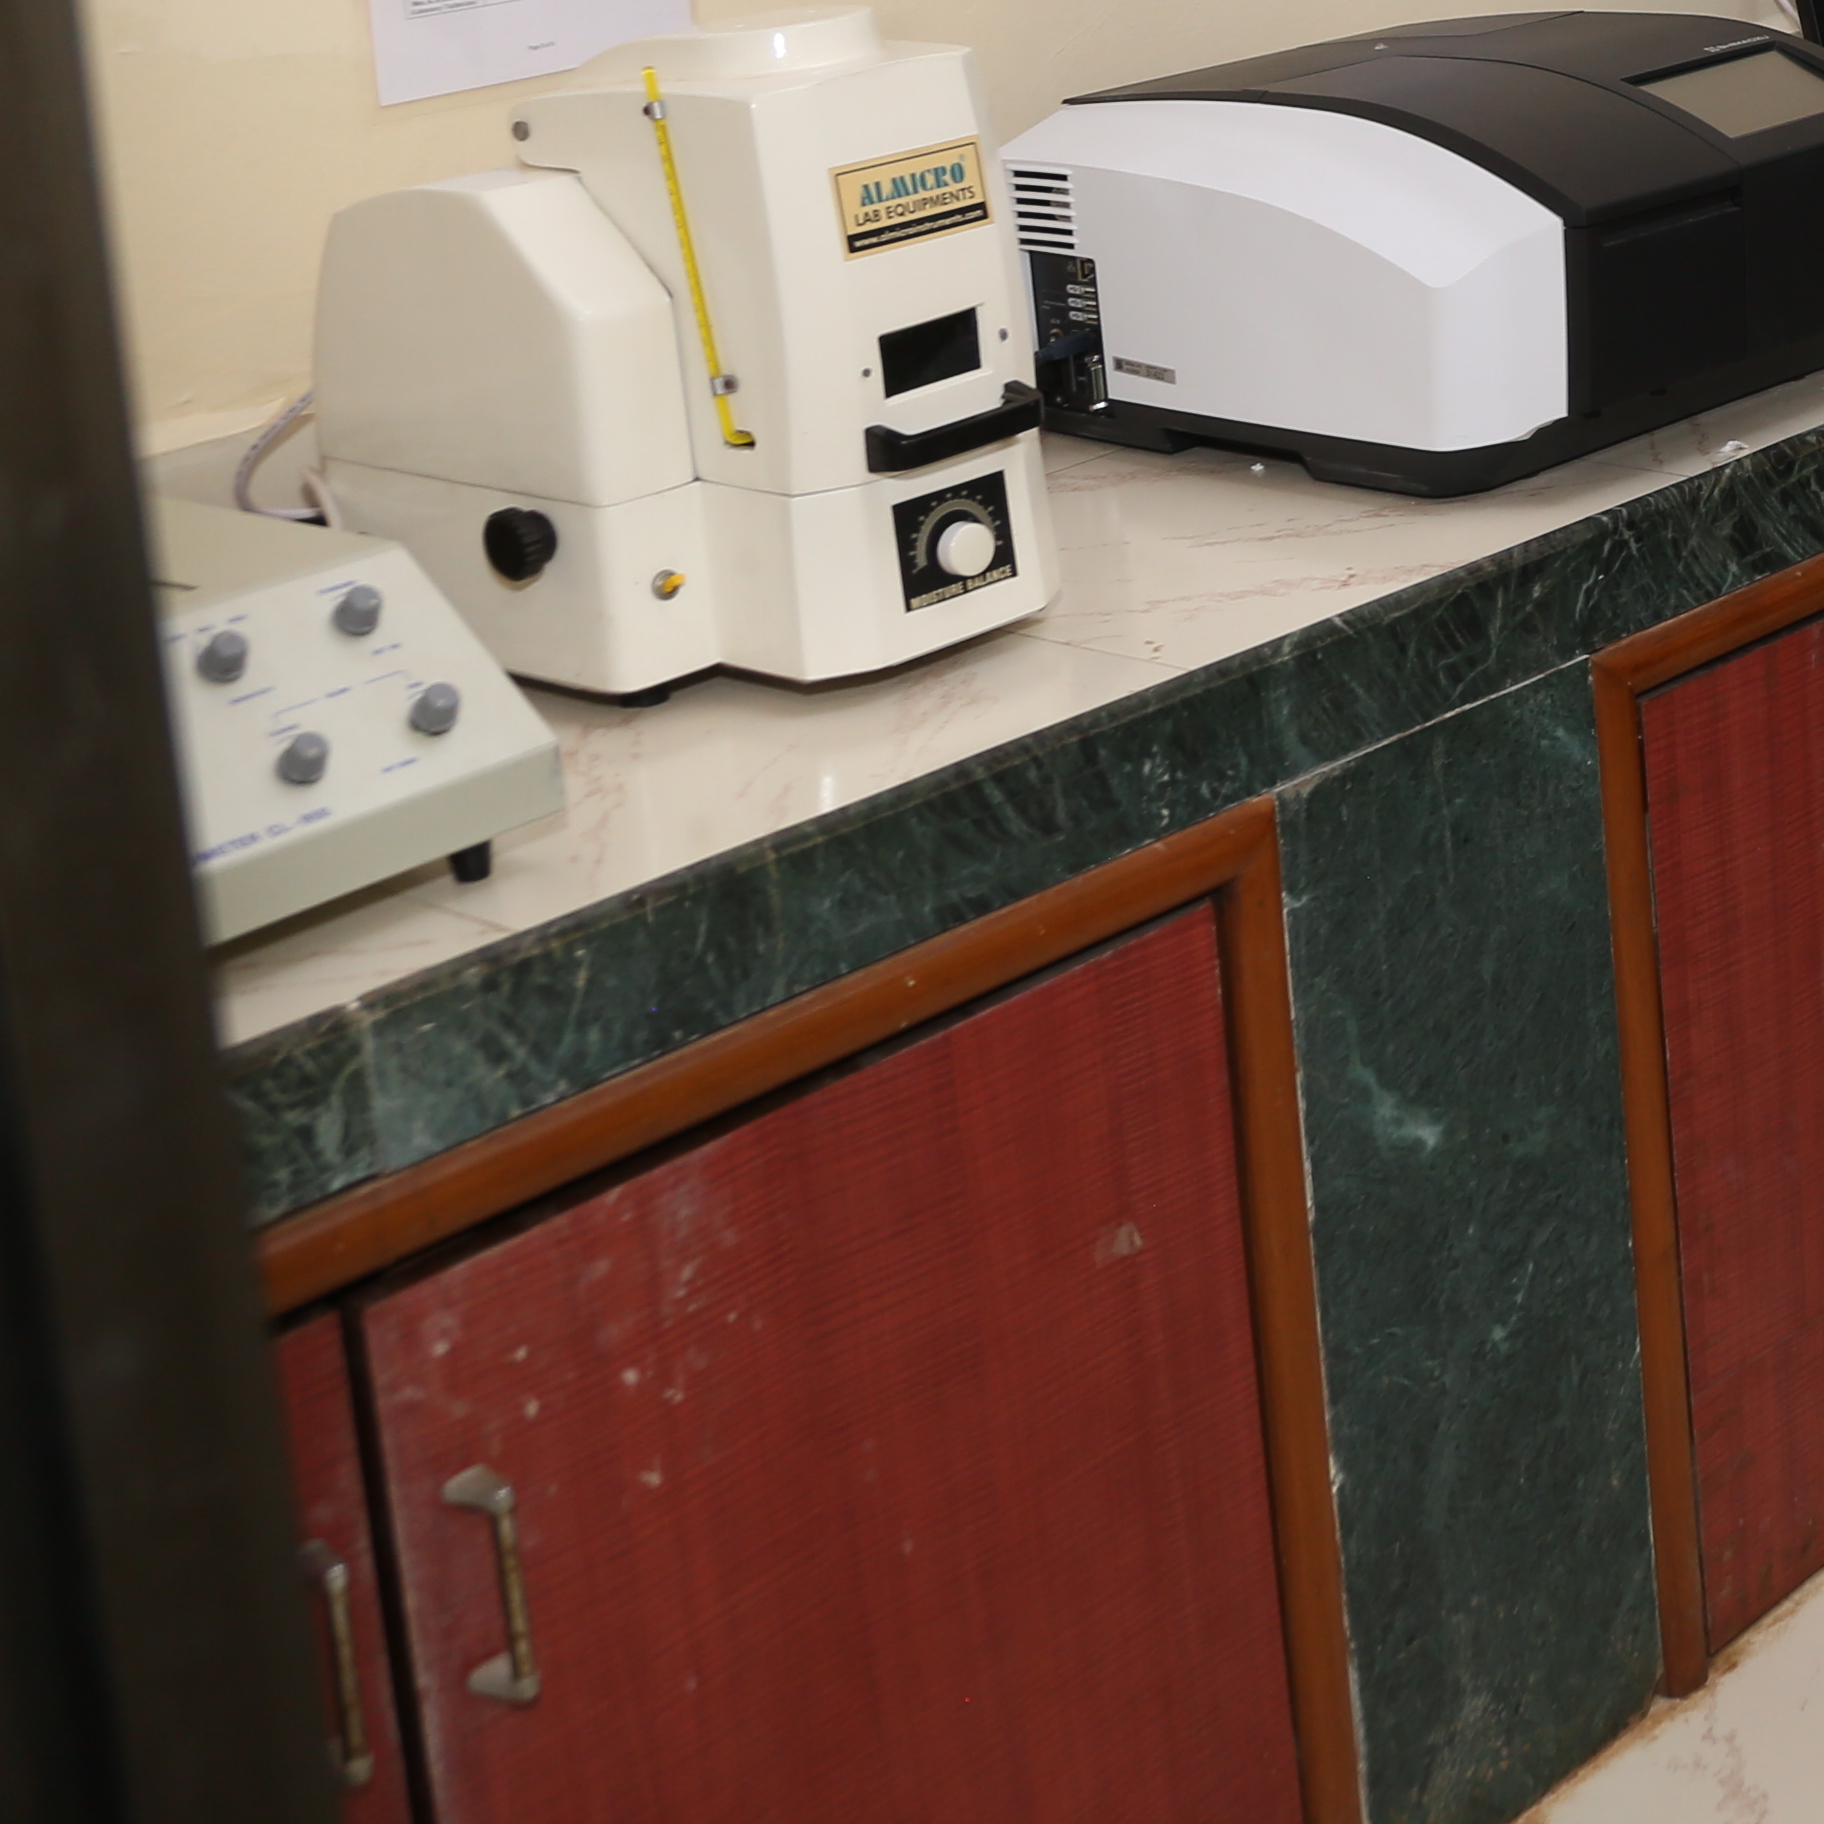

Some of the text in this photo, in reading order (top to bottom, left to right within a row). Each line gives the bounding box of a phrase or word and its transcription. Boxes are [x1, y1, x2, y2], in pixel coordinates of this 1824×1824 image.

[854, 186, 976, 226] LAB EQUIPMENTS
[861, 162, 965, 207] ALMICRO
[909, 564, 1013, 609] MOISTURE BALANCE
